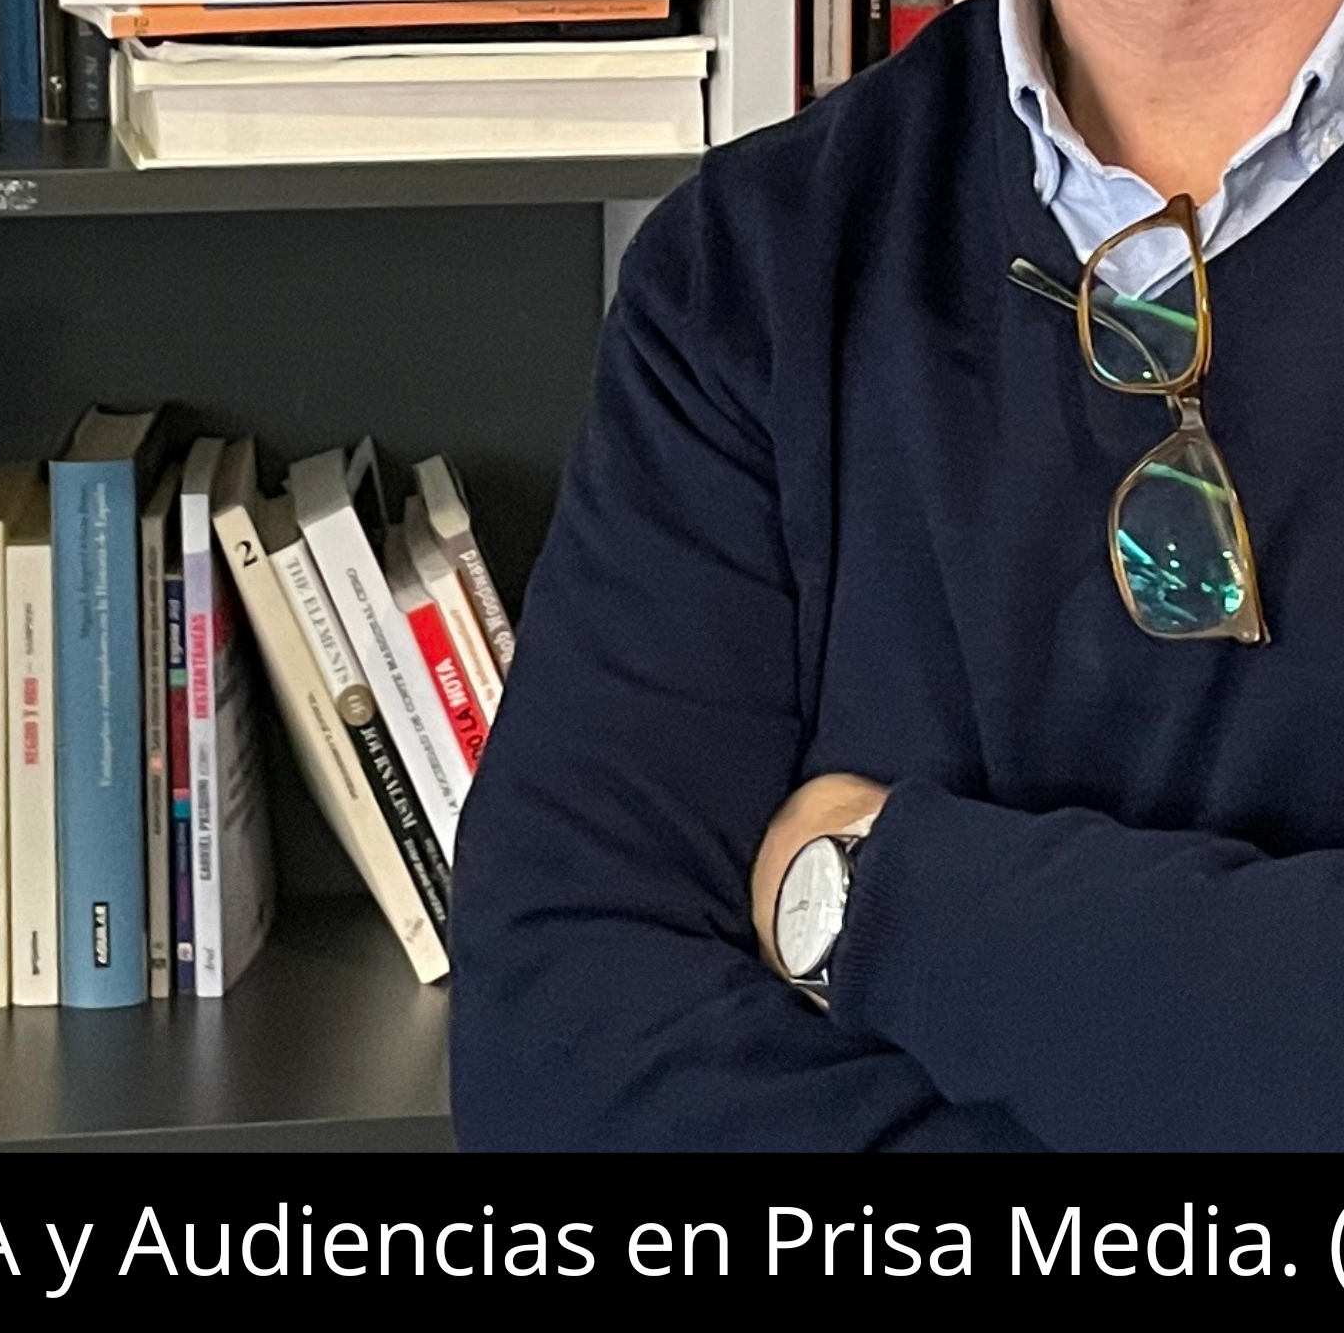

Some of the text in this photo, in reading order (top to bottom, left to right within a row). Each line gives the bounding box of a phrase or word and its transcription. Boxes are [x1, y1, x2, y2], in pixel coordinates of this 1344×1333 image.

[458, 549, 502, 632] Woodward
[285, 555, 309, 596] THE
[302, 597, 353, 686] ELEMENTS
[359, 725, 418, 829] JOURNALISM
[433, 657, 477, 729] LA NOTA
